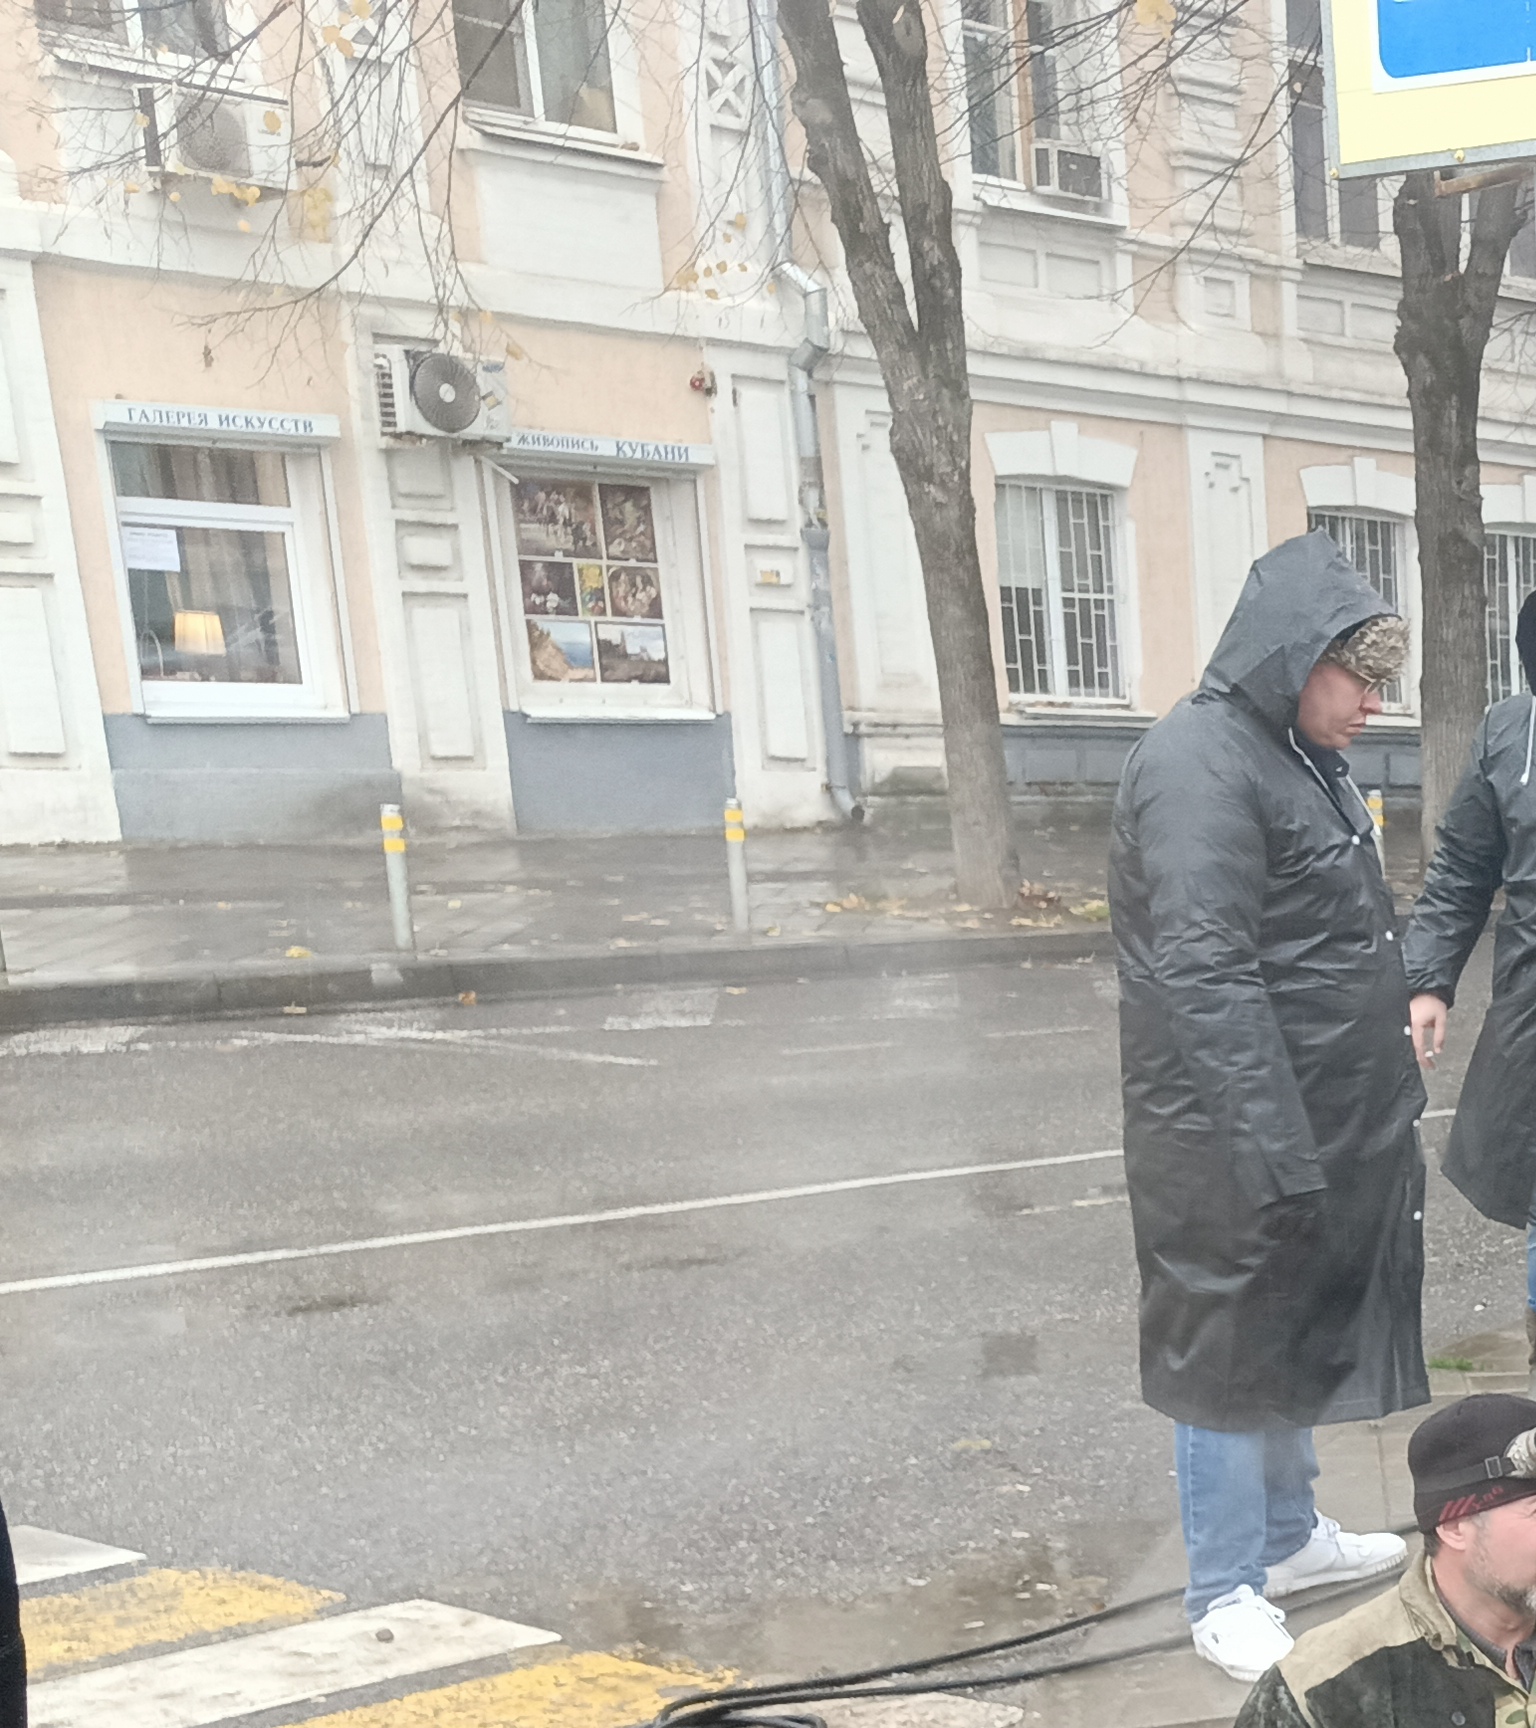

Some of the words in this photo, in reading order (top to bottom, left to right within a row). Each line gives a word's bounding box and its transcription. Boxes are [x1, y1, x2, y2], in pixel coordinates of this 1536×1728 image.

[127, 407, 209, 427] ГАЛЕРЕЯ
[218, 413, 314, 434] ИСКУССТВ
[517, 433, 599, 452] ЖИВОПИСЬ
[615, 440, 690, 462] КУБАНИ
